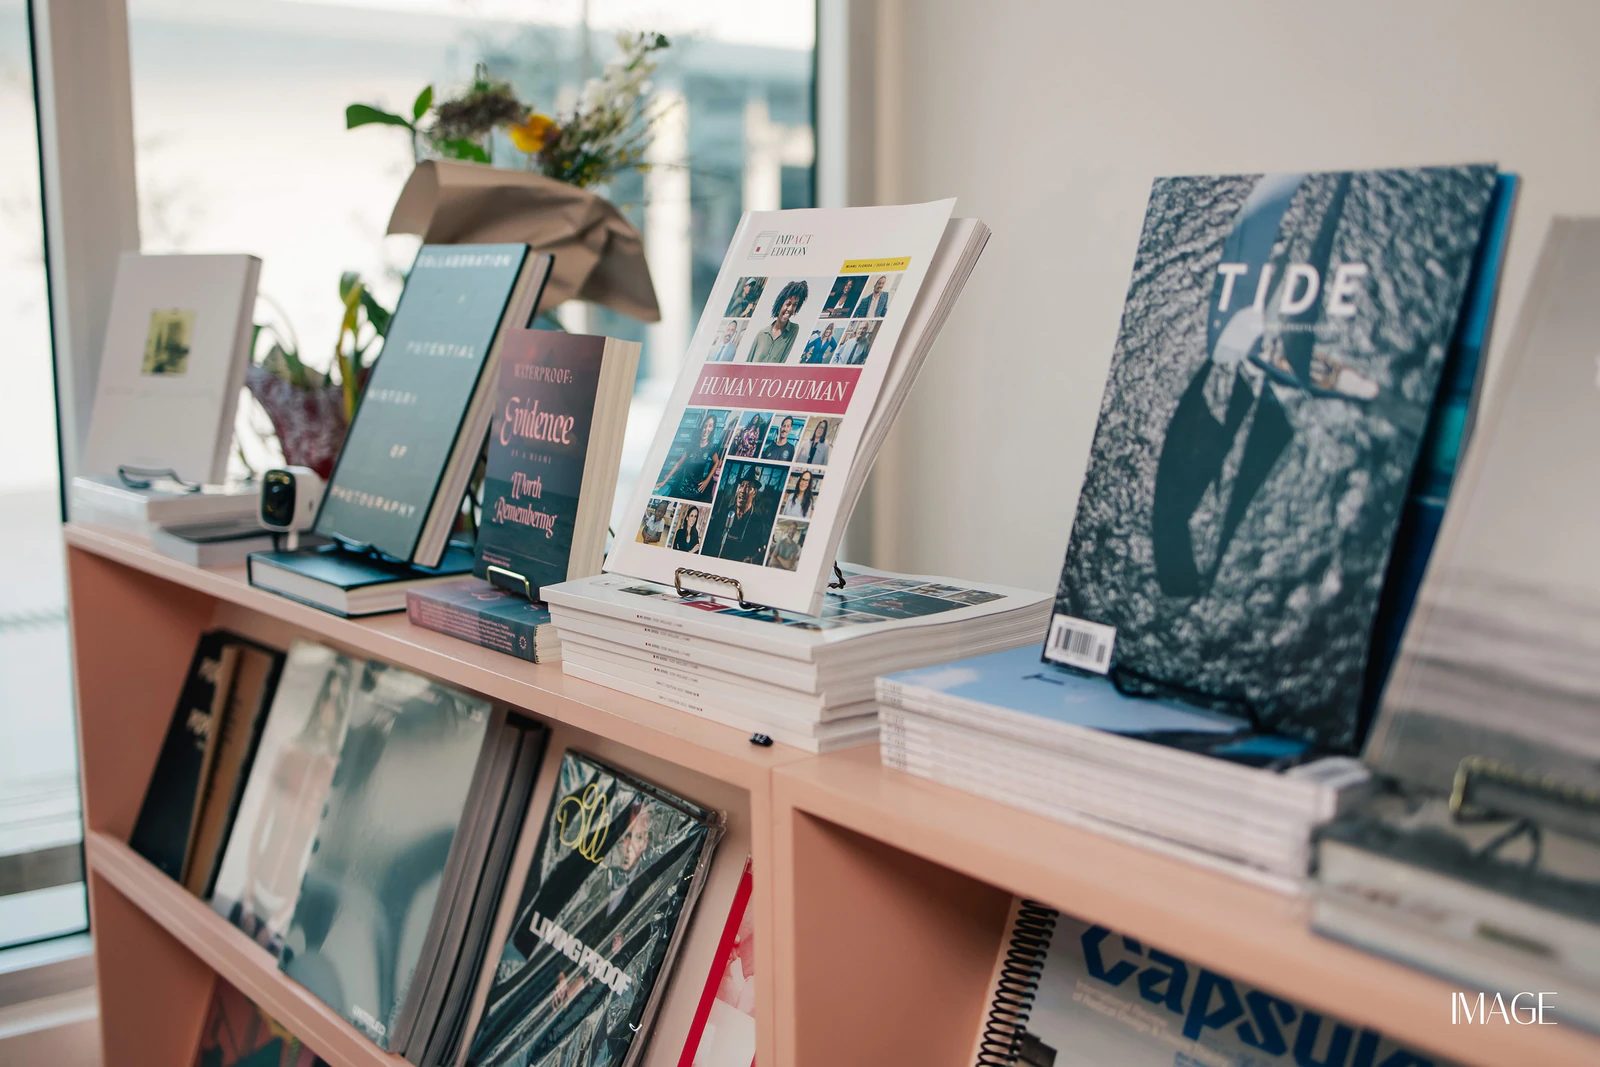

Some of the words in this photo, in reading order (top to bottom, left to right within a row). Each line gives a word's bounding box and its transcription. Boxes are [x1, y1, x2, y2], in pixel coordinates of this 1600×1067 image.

[770, 246, 809, 257] EDITION
[775, 234, 814, 247] IMPACT
[1217, 262, 1368, 317] TIDE
[405, 340, 477, 360] POTENTIAL
[514, 363, 573, 384] WATERPROOF:
[697, 375, 759, 397] HUMAN
[758, 378, 783, 398] TO
[779, 380, 850, 402] HUMAN
[500, 395, 575, 447] Evidence
[389, 443, 409, 458] OF
[511, 471, 543, 500] Worth
[330, 485, 417, 518] PHOTOGRAPHY
[492, 496, 558, 539] Remembering
